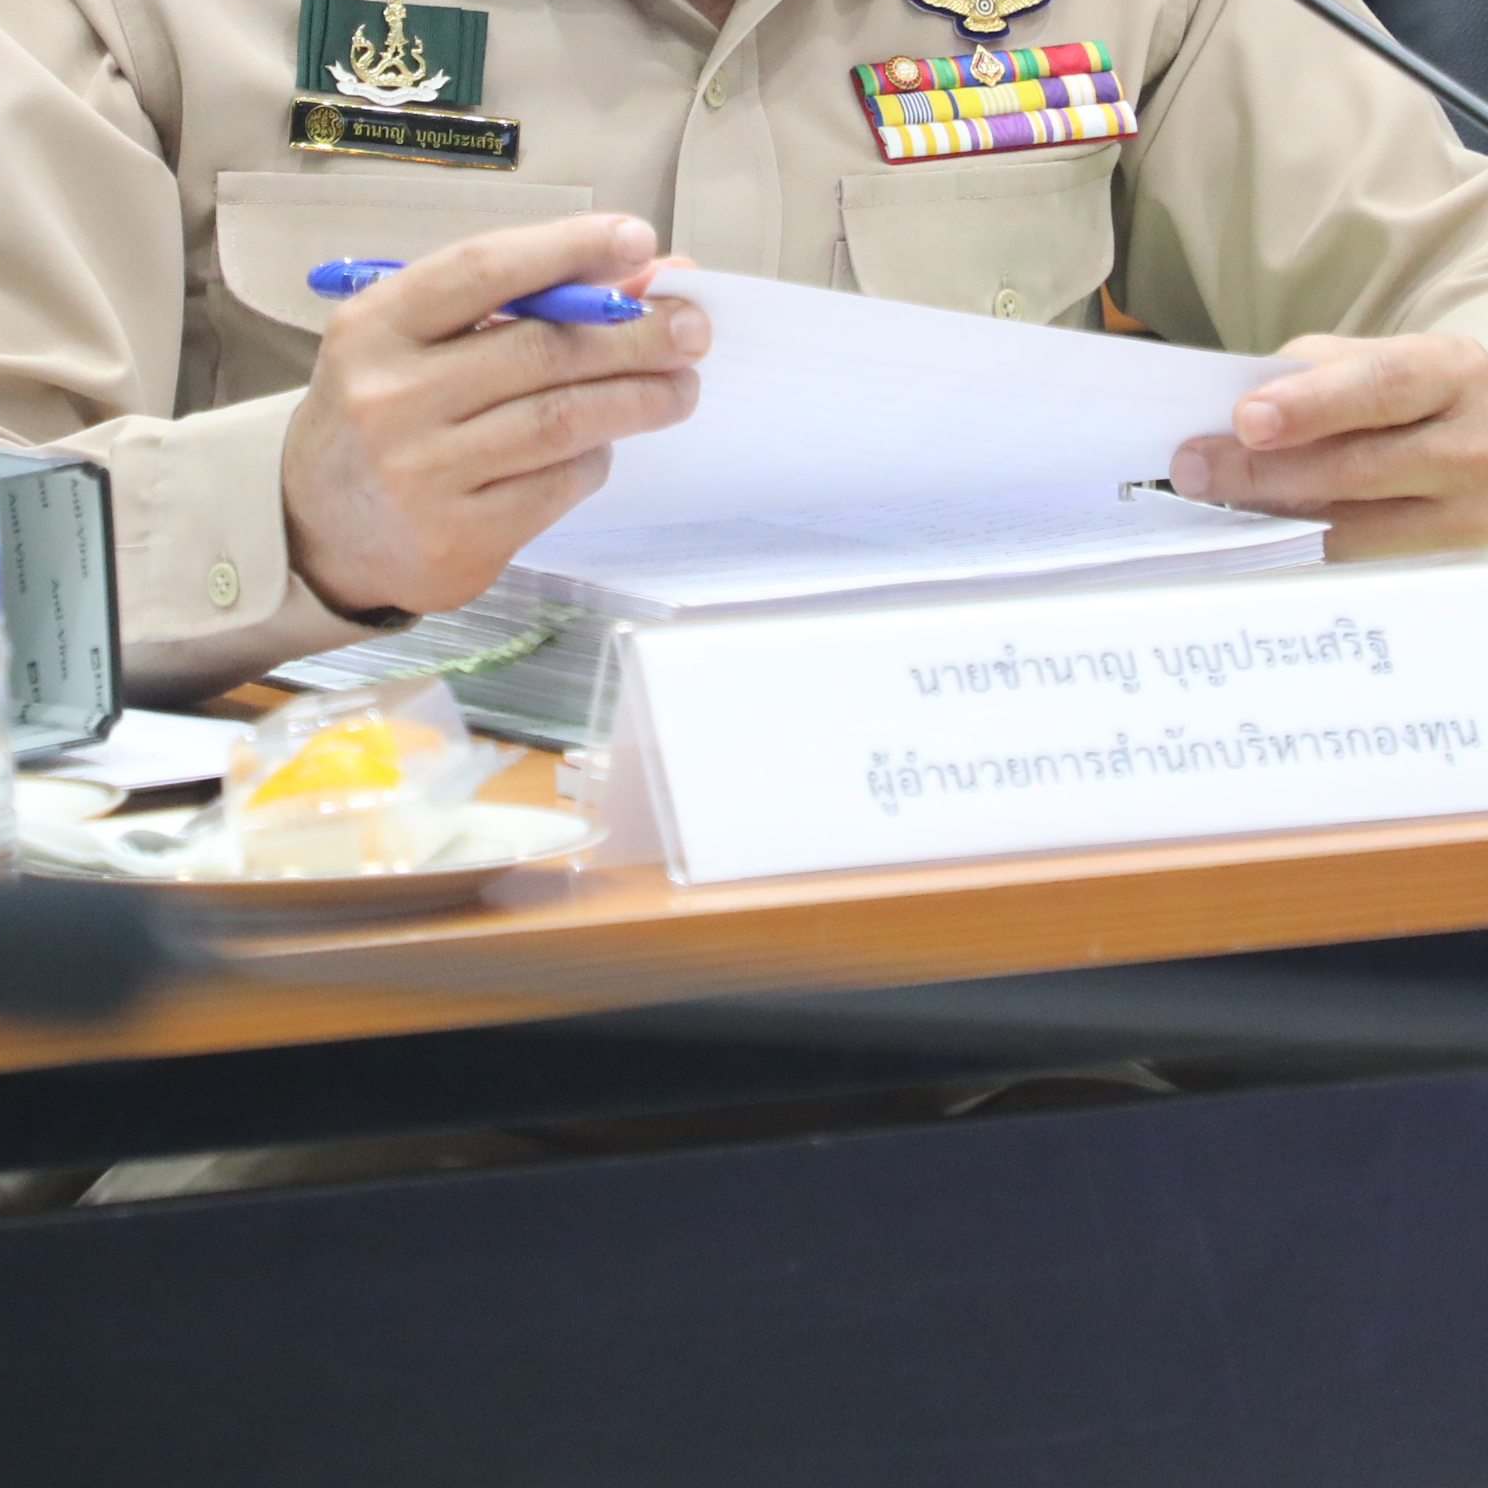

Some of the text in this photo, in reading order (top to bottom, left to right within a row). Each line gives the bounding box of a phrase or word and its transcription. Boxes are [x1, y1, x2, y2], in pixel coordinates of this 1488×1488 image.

[353, 118, 503, 155] ชำนาญ บุญประเสริฐ
[909, 616, 1394, 699] นายชำนาญ บุญประเสริฐ
[866, 718, 1482, 817] ผู้อำนวยการสำนักบริหารกองทุน
